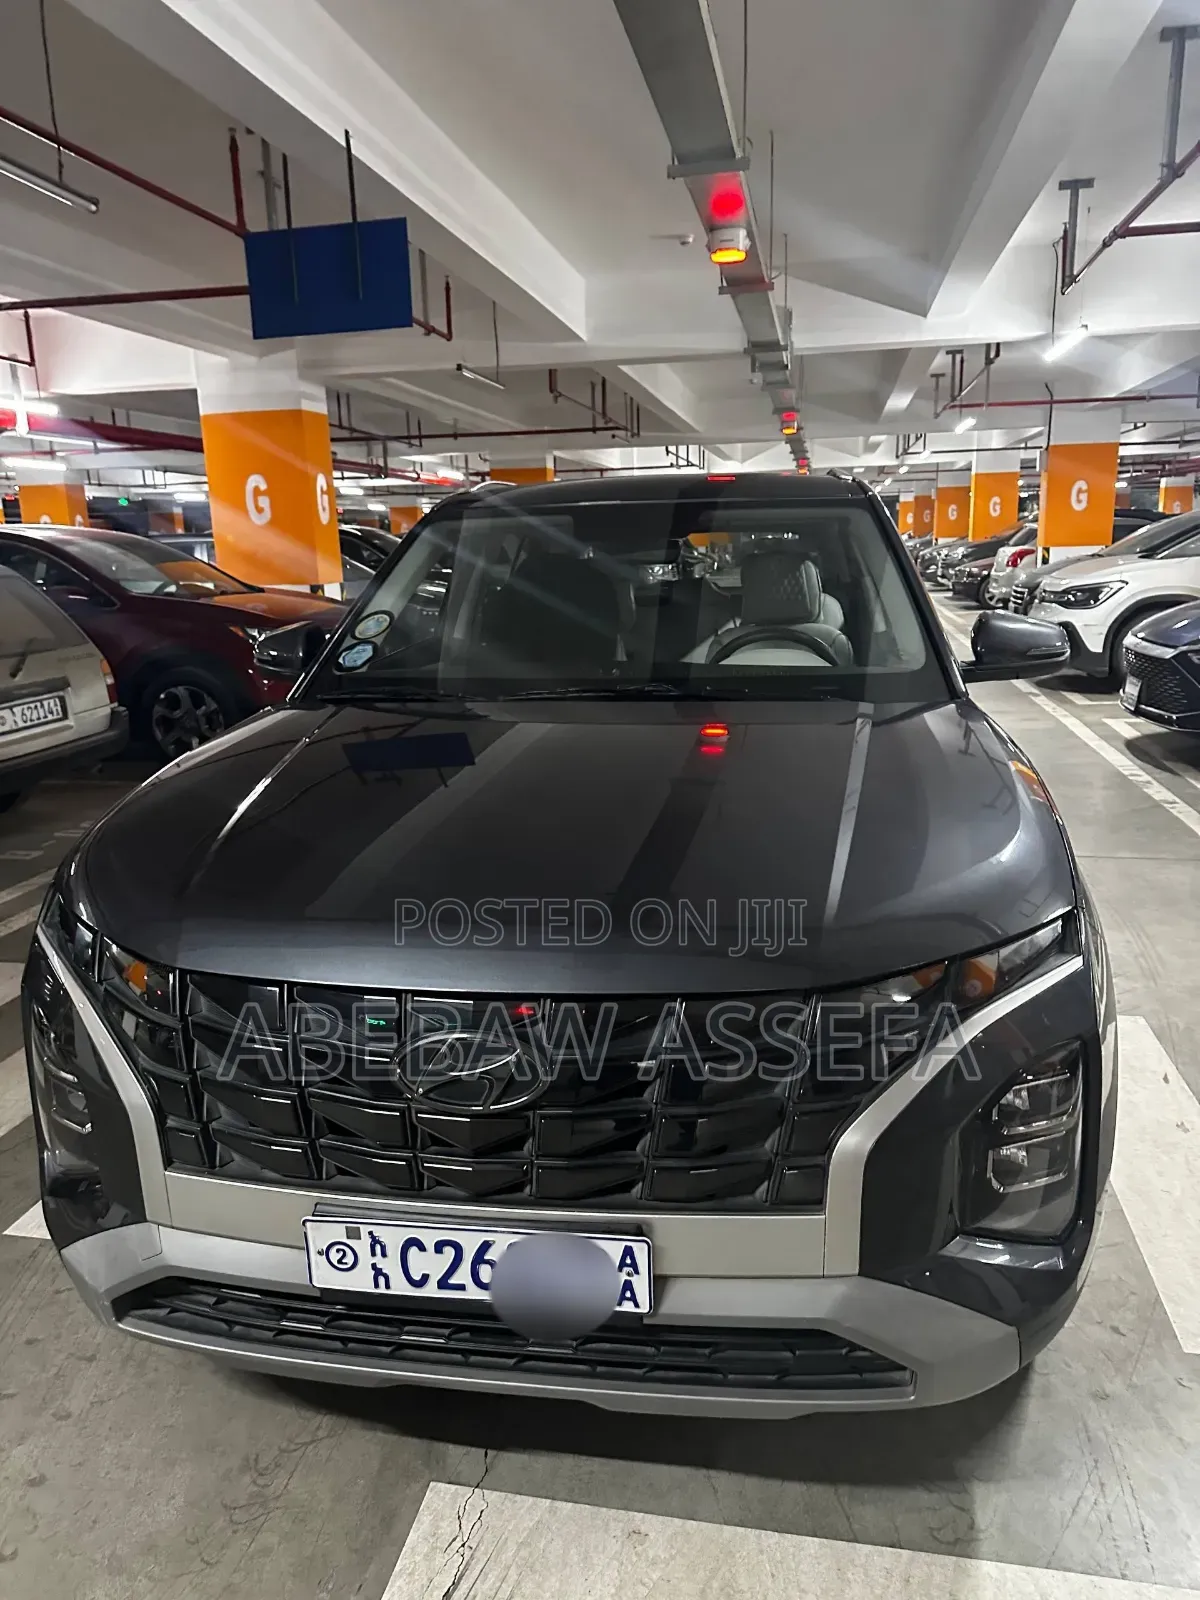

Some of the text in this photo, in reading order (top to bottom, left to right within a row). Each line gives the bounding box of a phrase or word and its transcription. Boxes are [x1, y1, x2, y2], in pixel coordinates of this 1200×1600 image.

[245, 474, 272, 525] G
[316, 473, 330, 525] G
[989, 496, 1001, 517] G
[1071, 480, 1088, 511] G
[948, 504, 957, 520] G
[336, 1248, 348, 1265] 2
